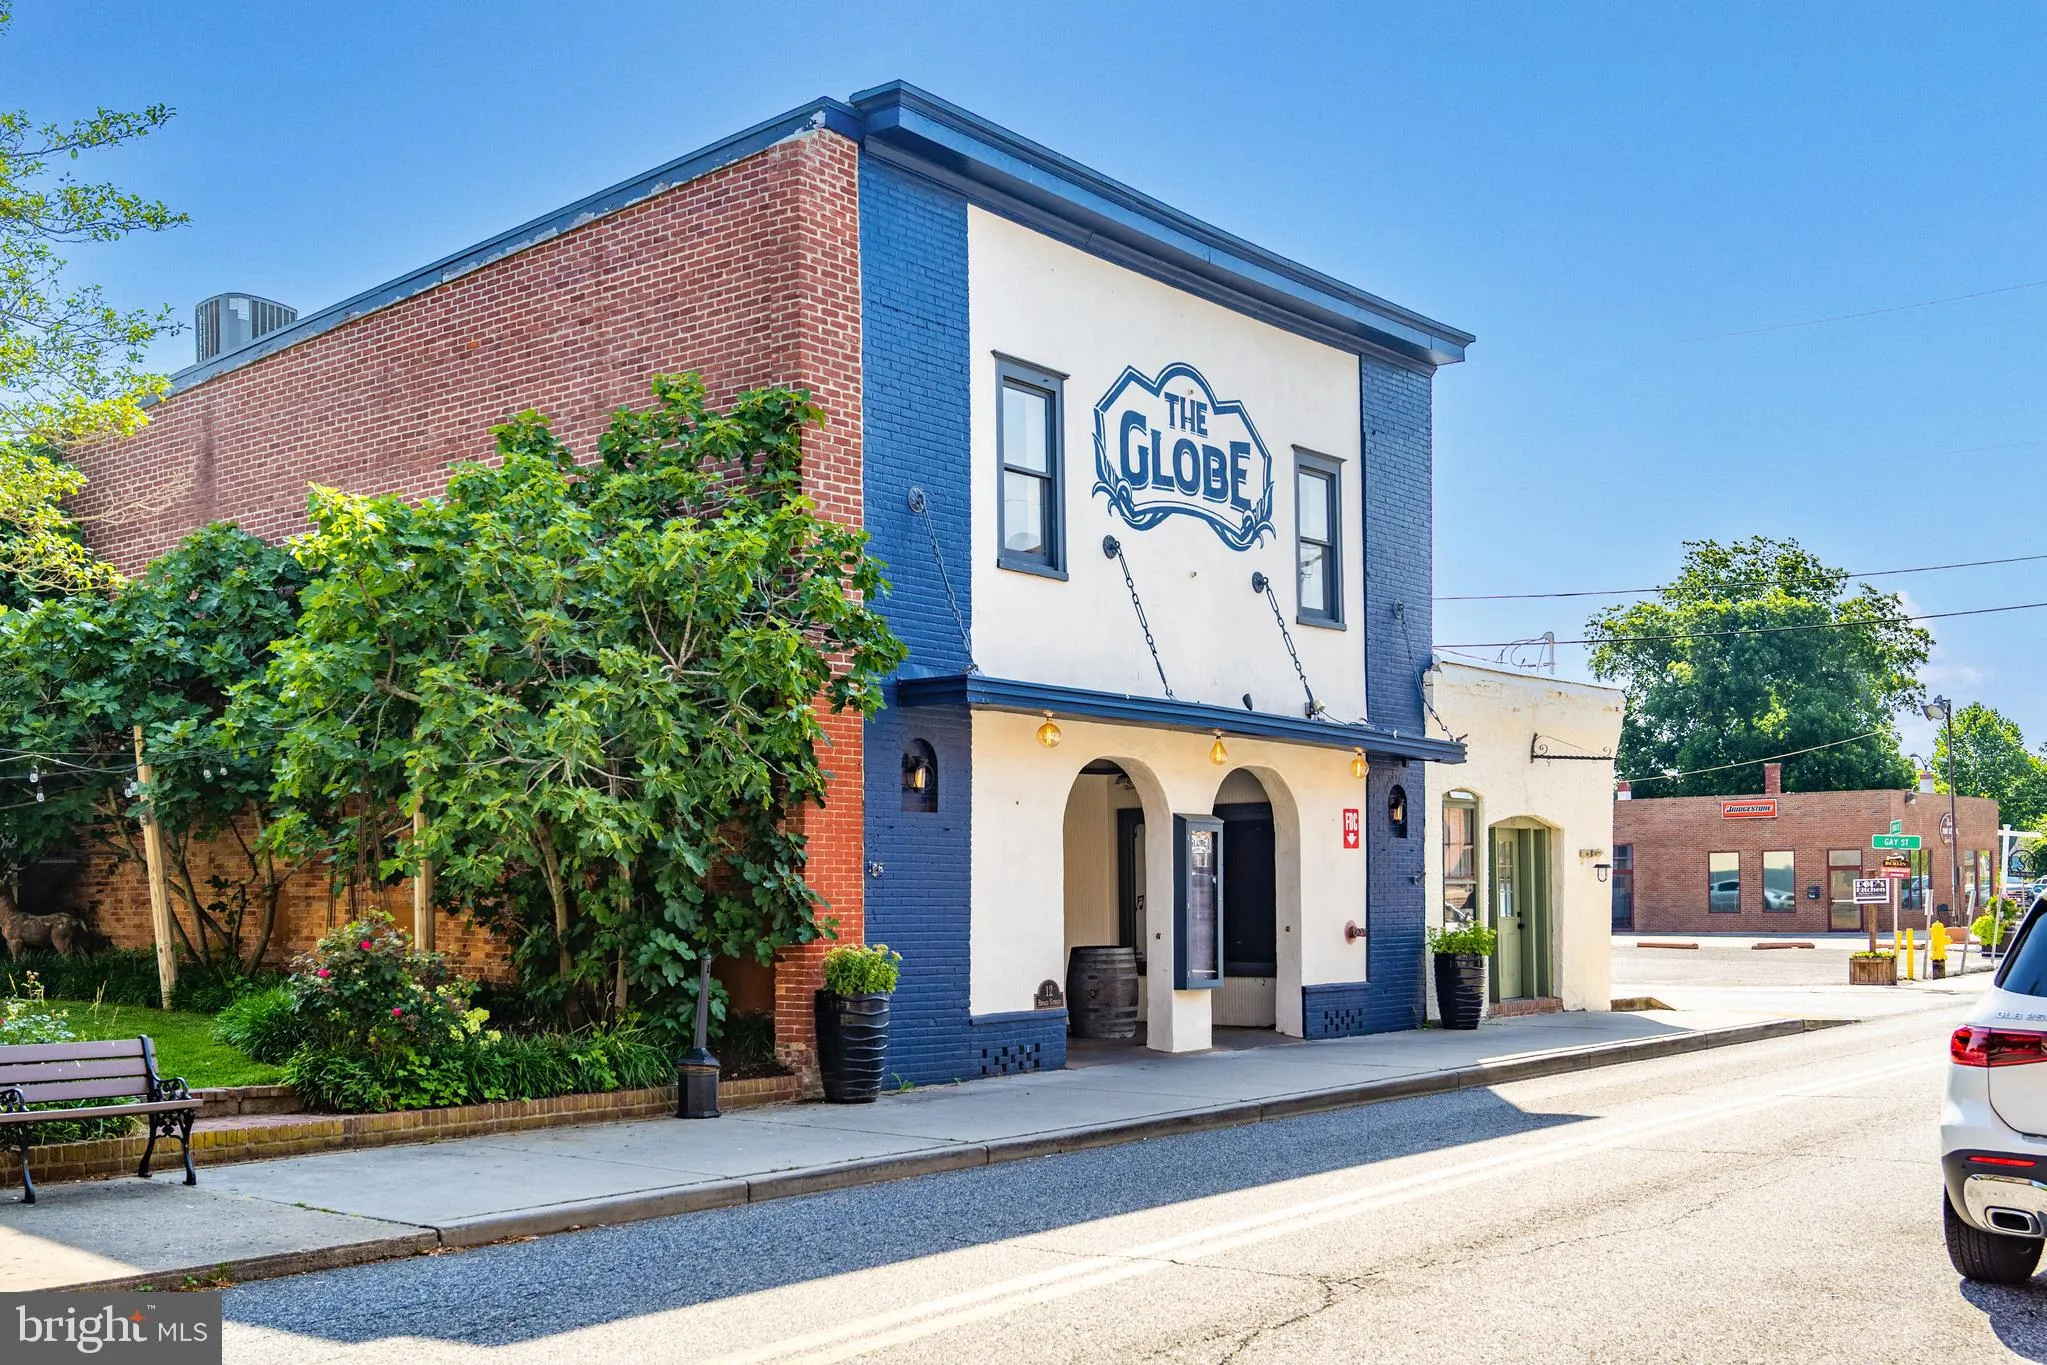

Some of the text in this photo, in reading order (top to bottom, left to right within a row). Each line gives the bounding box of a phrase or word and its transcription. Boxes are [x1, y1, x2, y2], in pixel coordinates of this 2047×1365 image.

[1164, 391, 1208, 438] THE
[1119, 410, 1252, 513] GLOBE
[1345, 812, 1358, 831] FDC
[1884, 838, 1909, 847] GAY ST
[1045, 985, 1053, 997] 12
[1995, 1010, 2022, 1019] GLB
